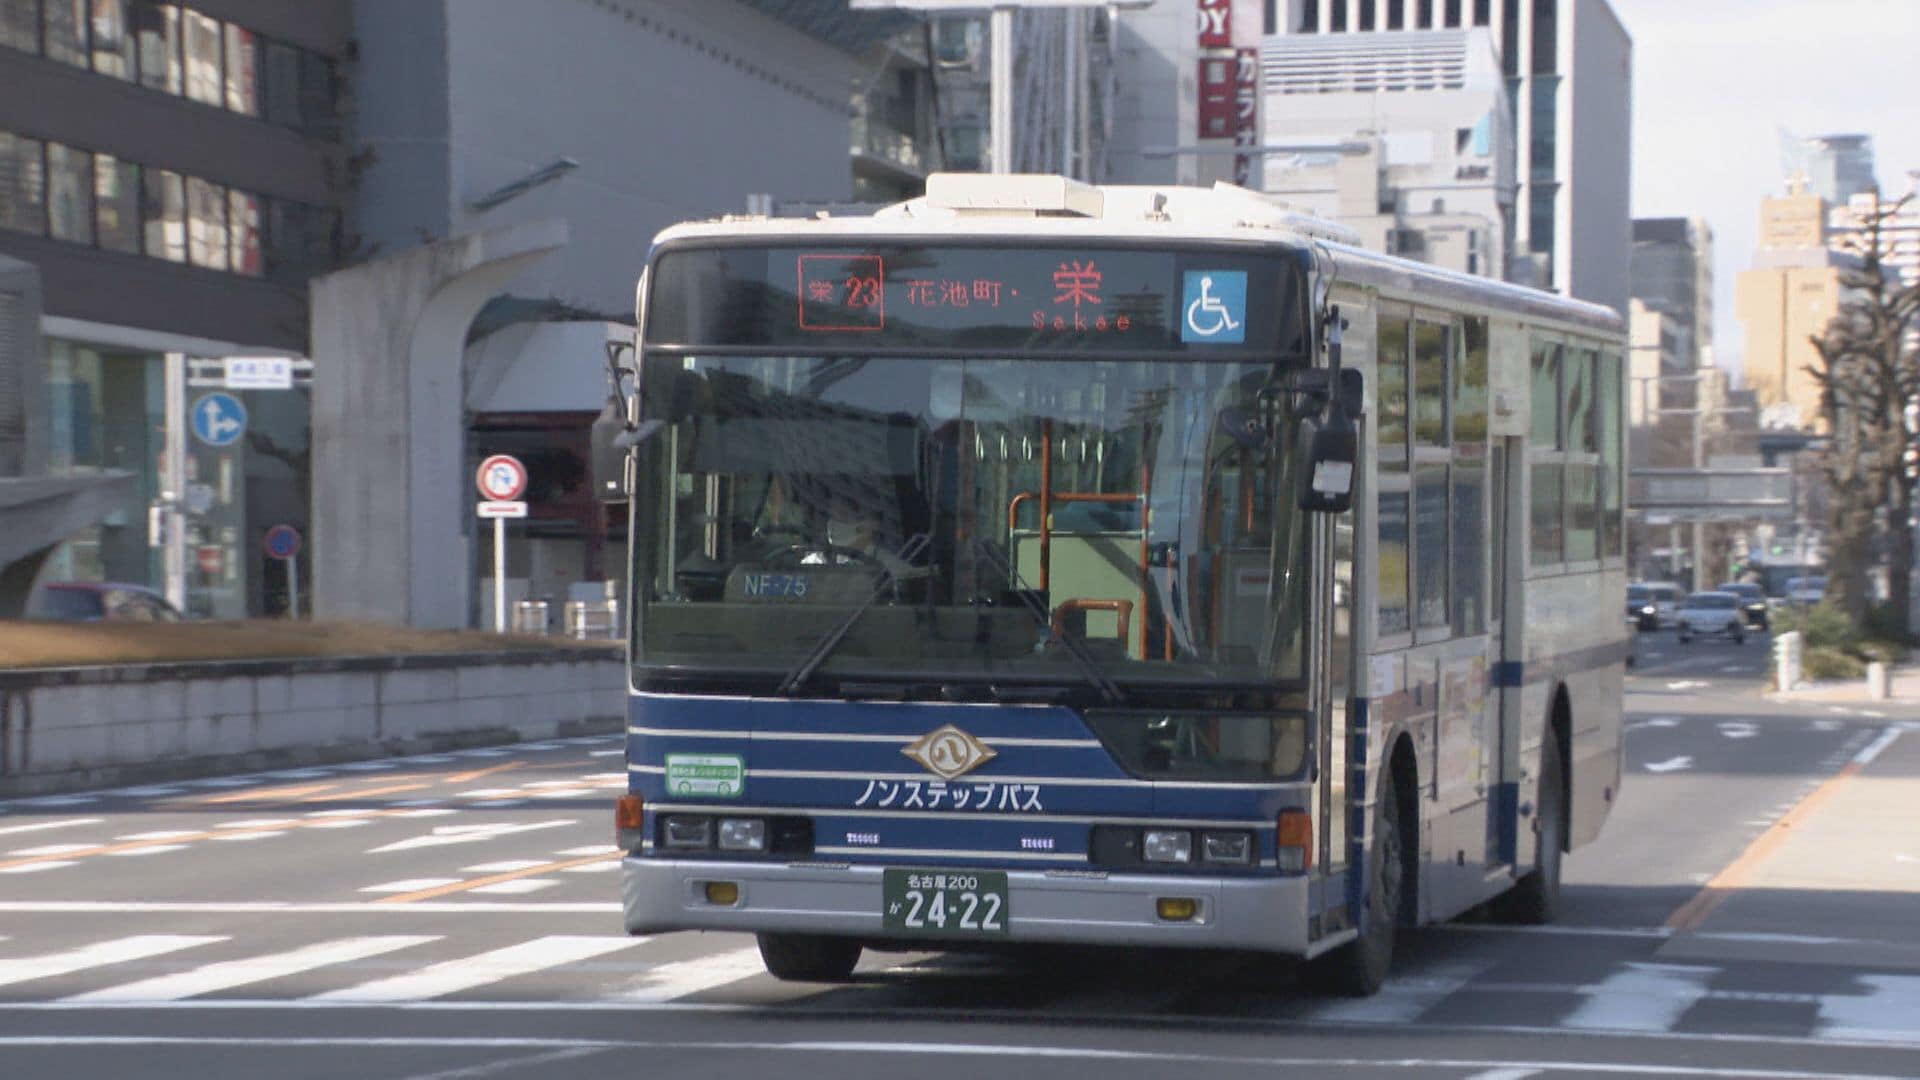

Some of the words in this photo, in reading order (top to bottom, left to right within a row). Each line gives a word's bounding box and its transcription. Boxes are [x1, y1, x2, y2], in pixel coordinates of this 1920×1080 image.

[844, 277, 881, 308] 23
[1052, 259, 1102, 307] 栄
[1032, 311, 1131, 332] Sakae
[743, 574, 807, 597] NF-75
[854, 779, 1043, 811] ノンステップバス
[904, 890, 1001, 931] 24-22
